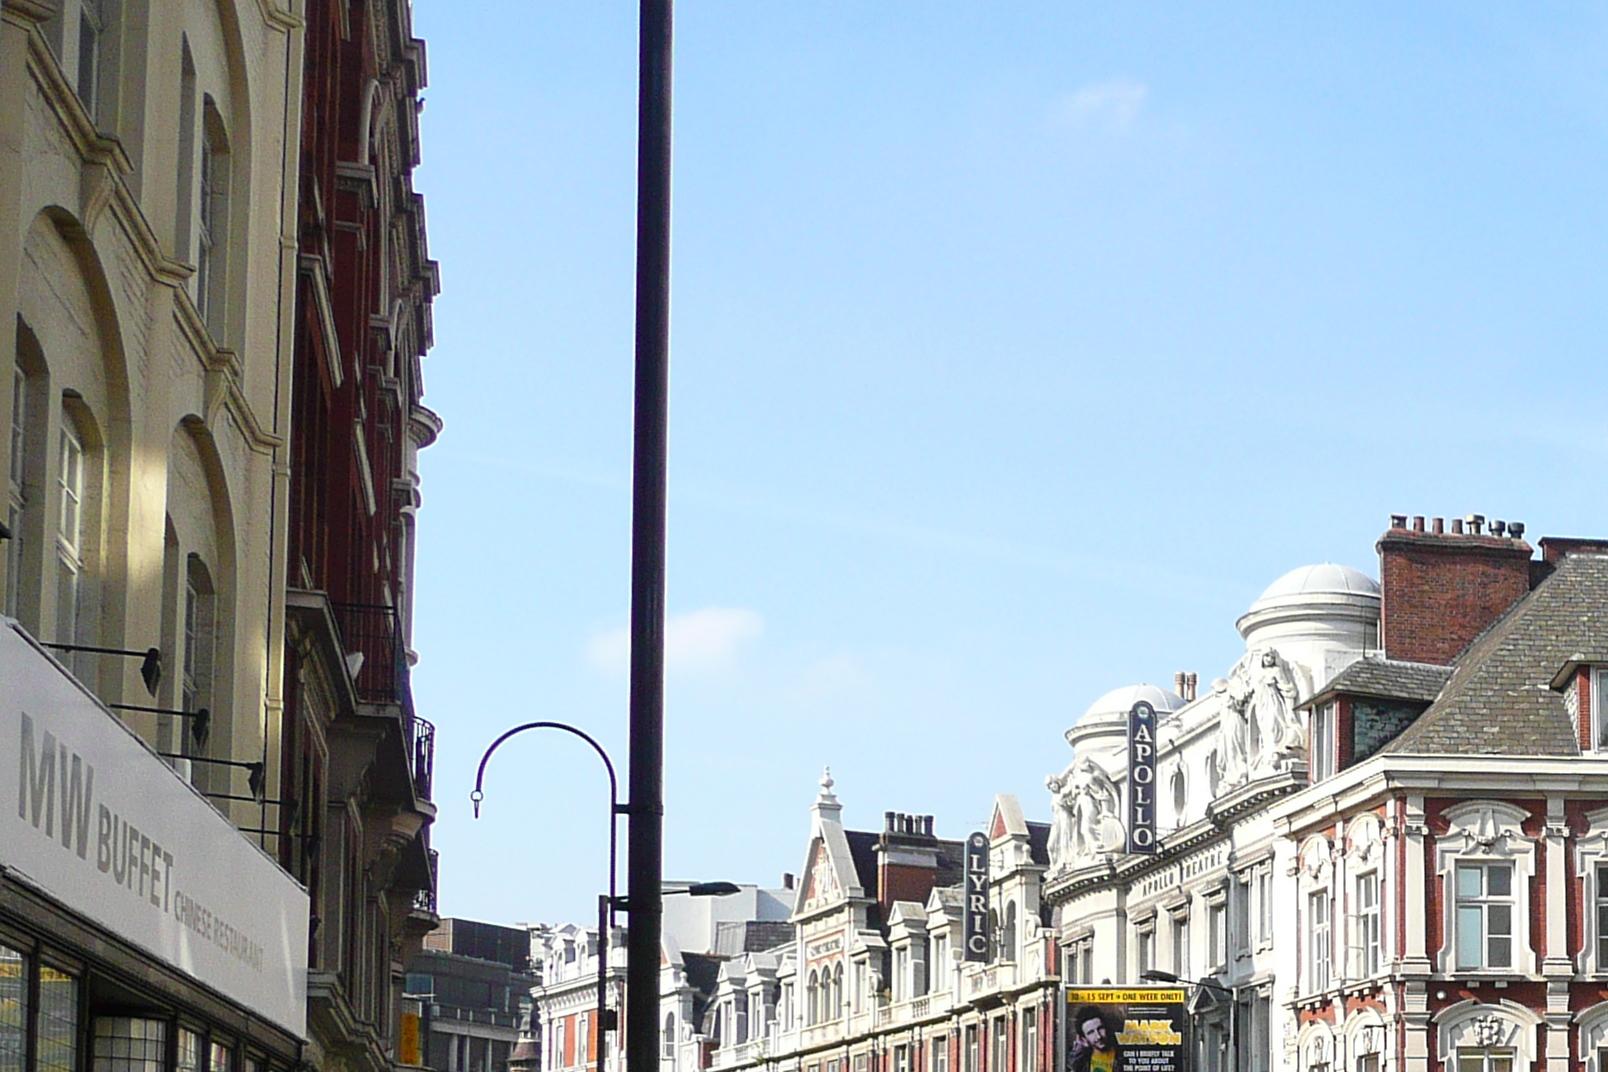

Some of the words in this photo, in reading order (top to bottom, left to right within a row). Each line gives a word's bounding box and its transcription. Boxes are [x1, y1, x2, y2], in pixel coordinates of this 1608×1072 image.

[18, 711, 95, 861] MW
[97, 803, 174, 914] BUFFET
[1133, 724, 1154, 847] APOLLO
[968, 854, 988, 954] LYRIC
[1142, 872, 1175, 898] APOLLO
[1122, 992, 1137, 1001] ONE
[1139, 992, 1159, 1001] WEEK
[1124, 1019, 1173, 1033] MARK
